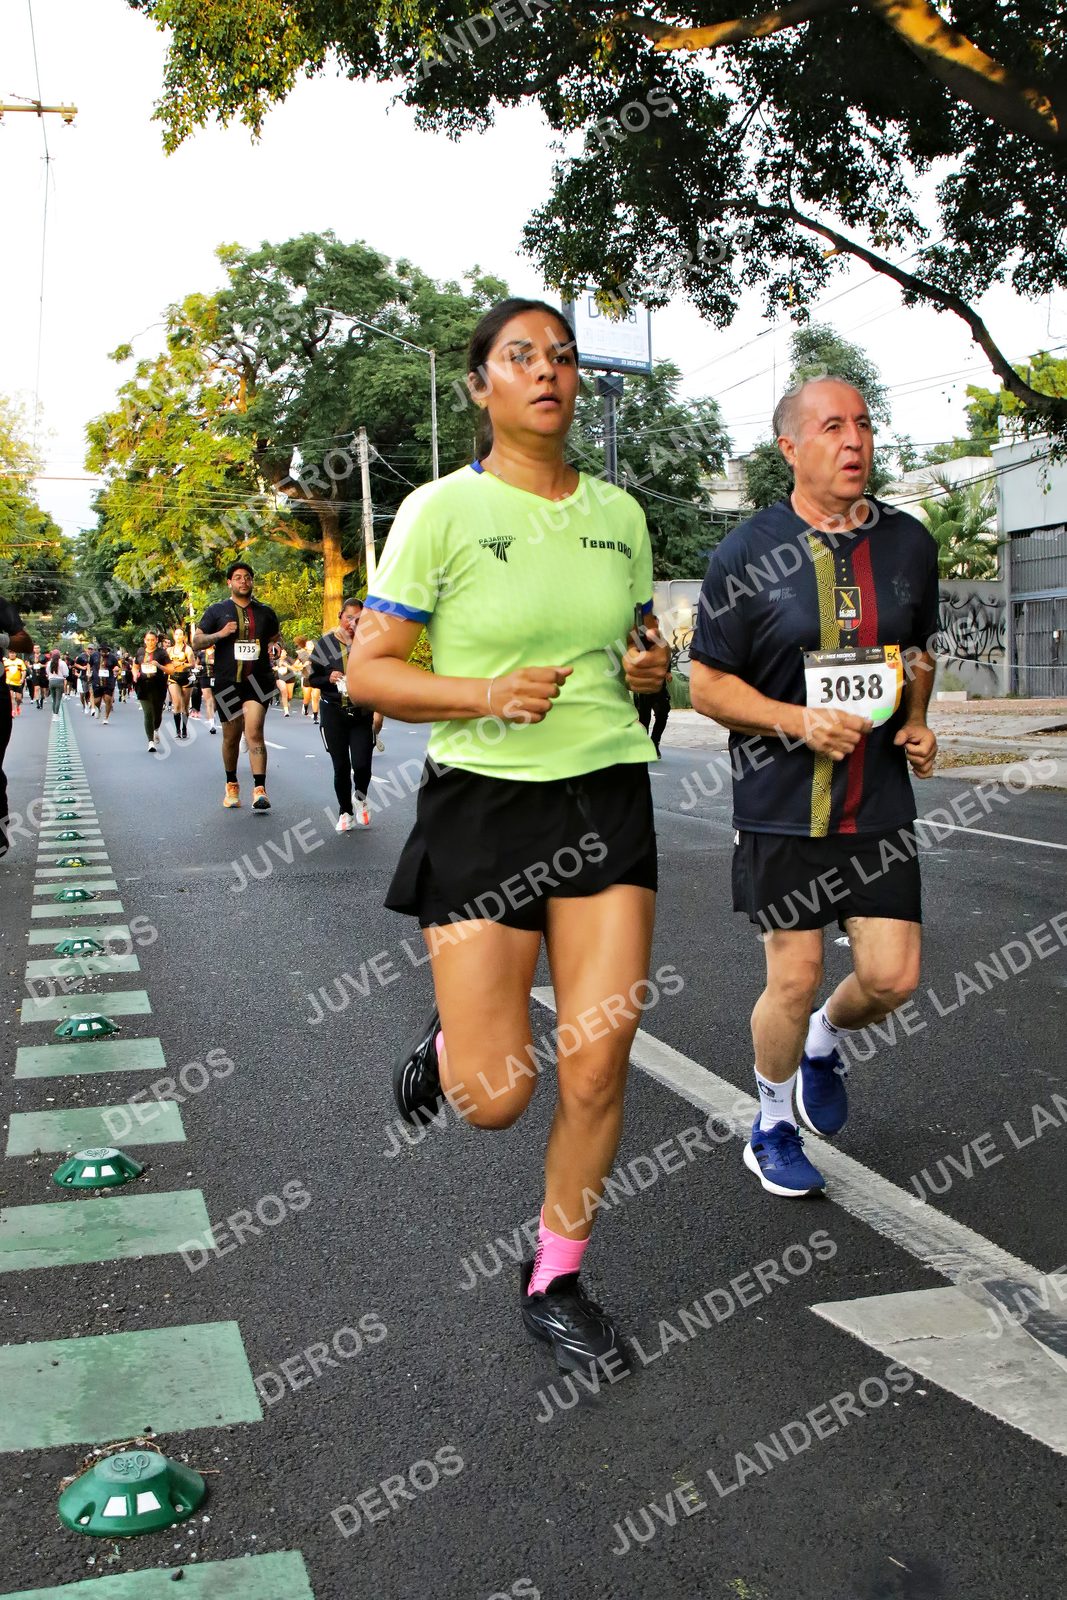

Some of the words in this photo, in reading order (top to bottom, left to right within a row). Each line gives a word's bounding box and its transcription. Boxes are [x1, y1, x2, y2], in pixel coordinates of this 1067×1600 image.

[478, 535, 514, 545] PAJARITO
[579, 537, 615, 550] Team
[617, 541, 632, 560] ORO
[238, 645, 256, 653] 1735
[820, 673, 884, 704] 3038
